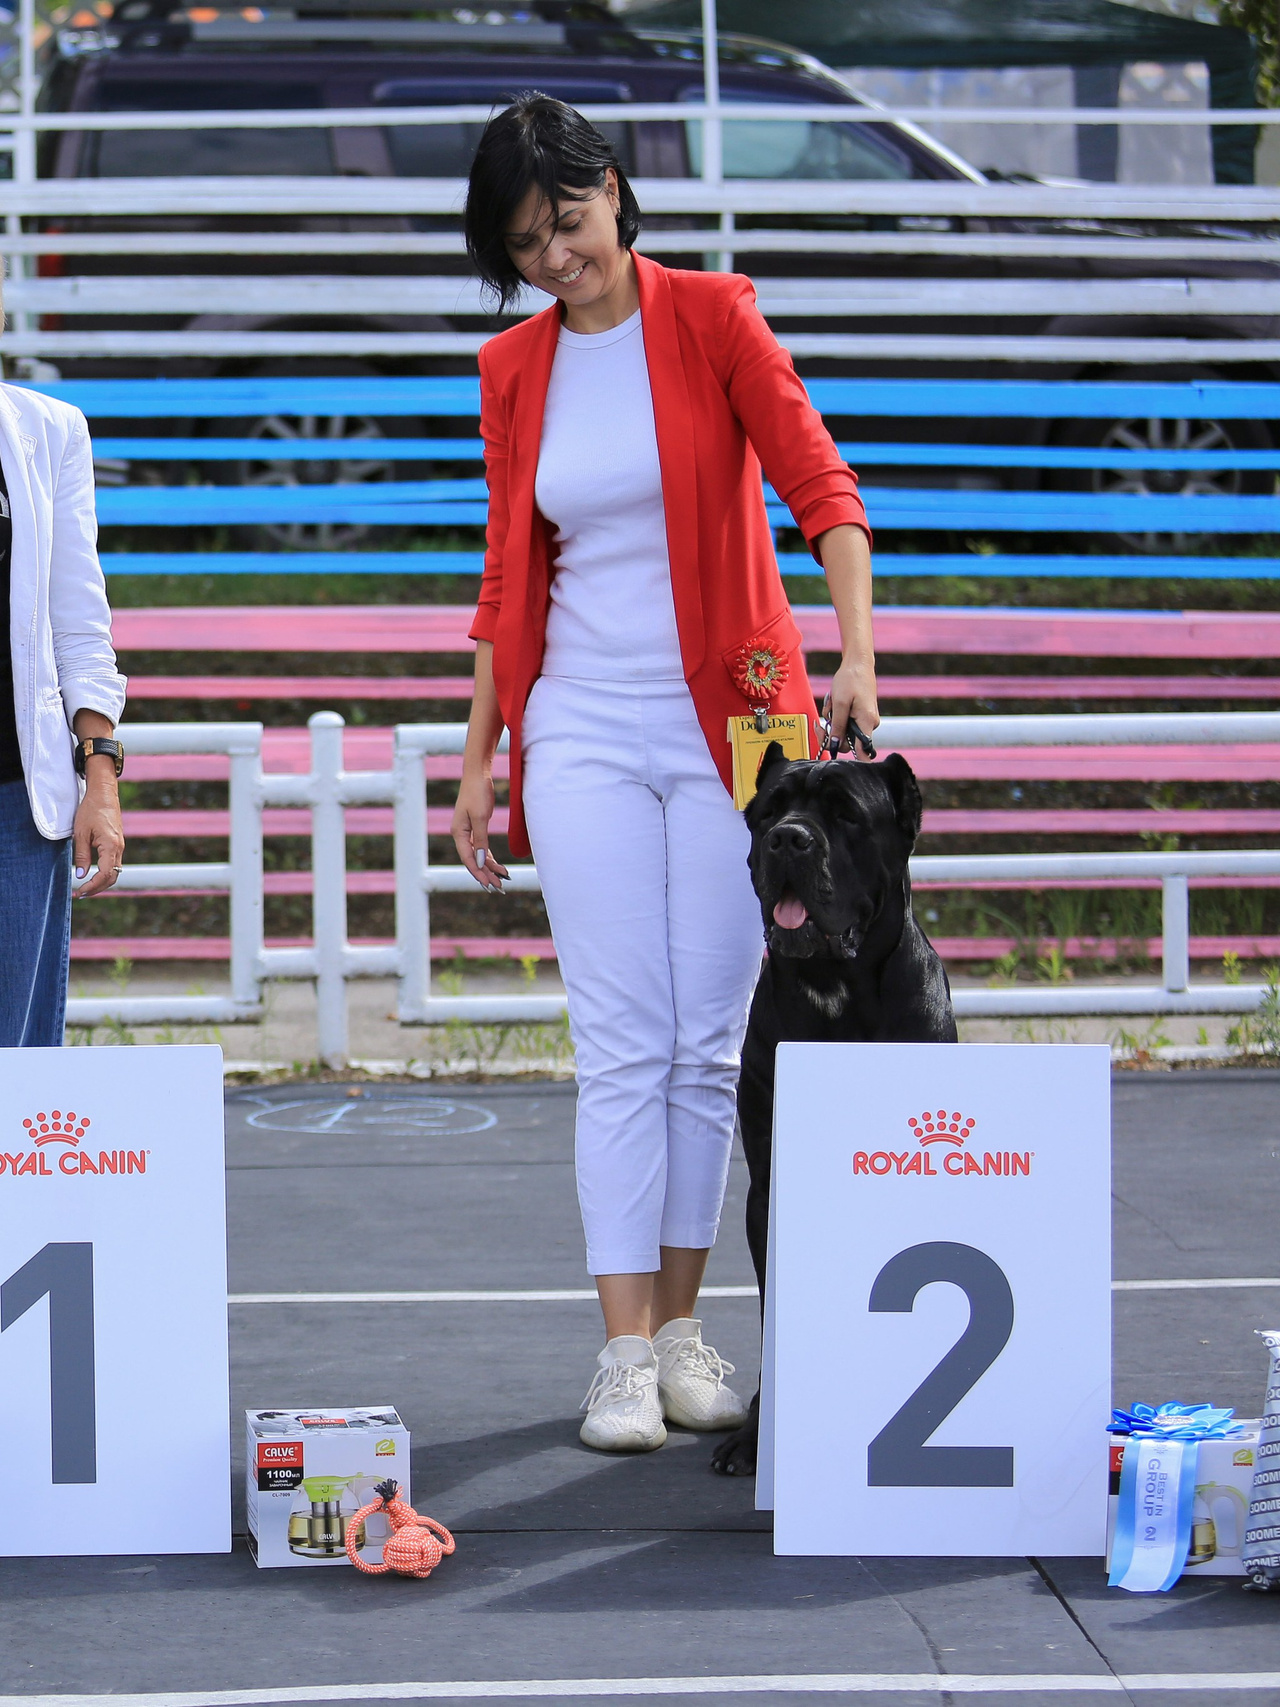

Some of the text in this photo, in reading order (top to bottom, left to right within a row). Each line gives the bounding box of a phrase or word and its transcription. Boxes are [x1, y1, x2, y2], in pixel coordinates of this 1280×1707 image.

[58, 1149, 147, 1176] CANIN
[852, 1150, 1030, 1177] ROYAL CANIN
[0, 1241, 97, 1485] 1
[867, 1240, 1014, 1487] 2
[264, 1446, 295, 1457] CALVE
[1143, 1458, 1161, 1517] GROUP
[1155, 1472, 1168, 1517] BEST IN
[1144, 1526, 1157, 1542] 2
